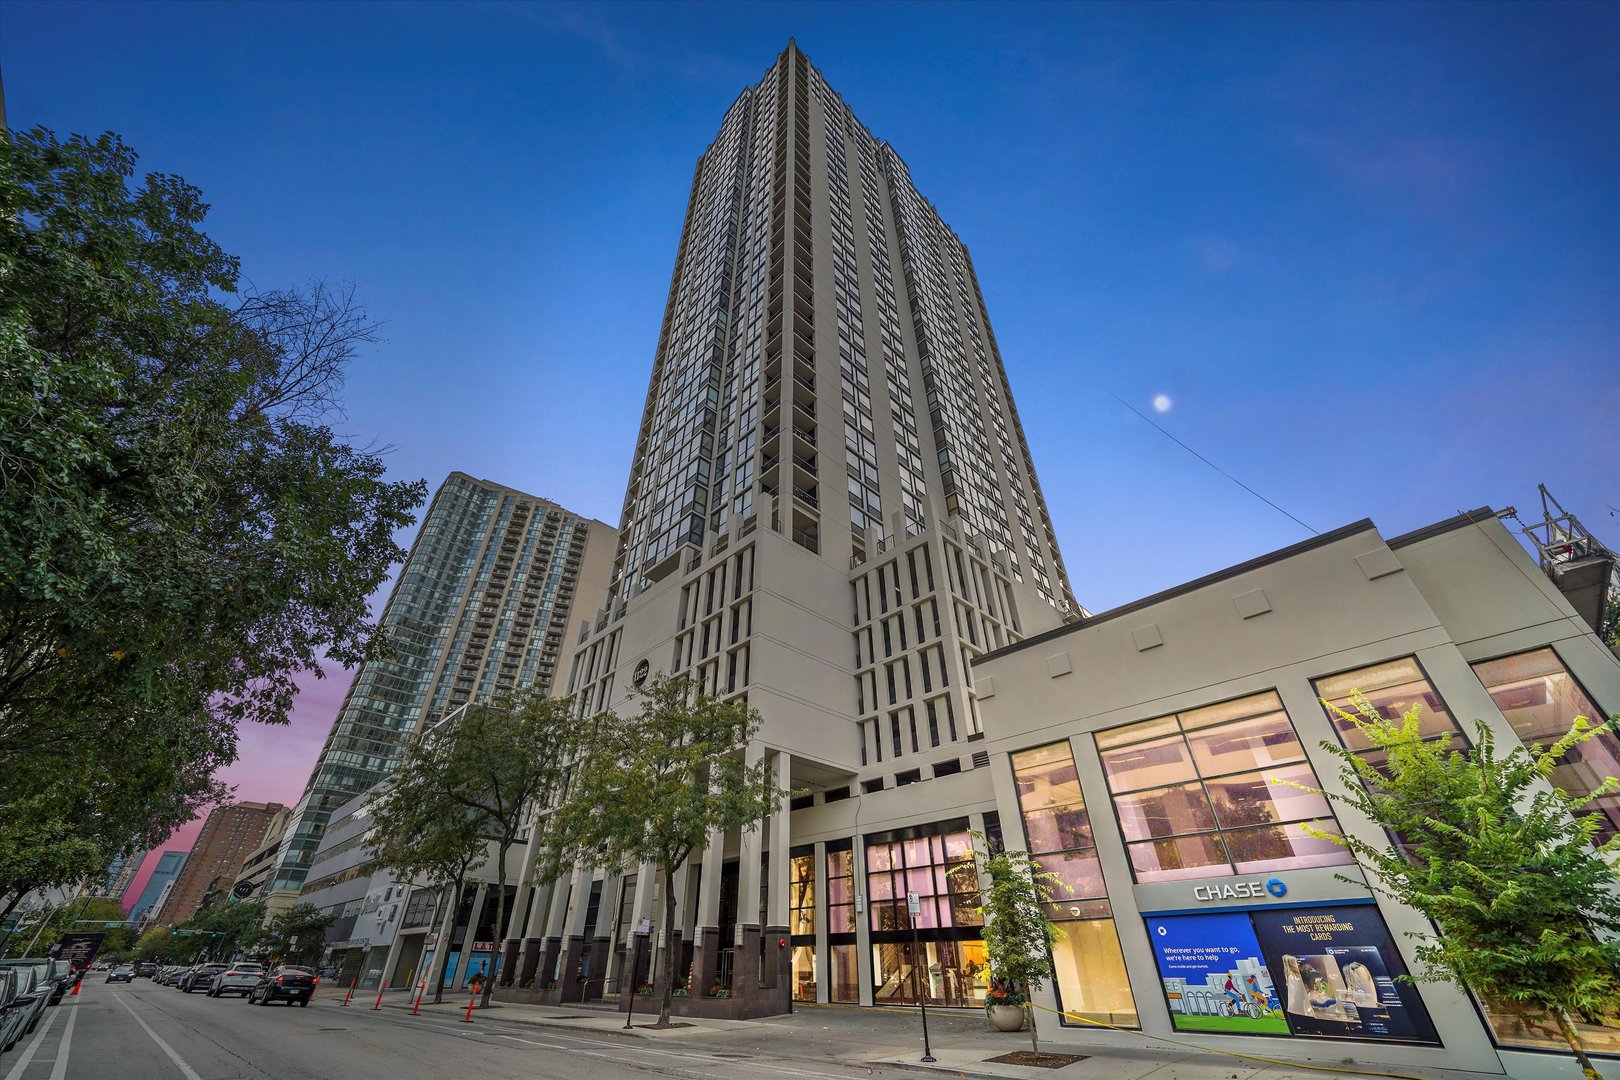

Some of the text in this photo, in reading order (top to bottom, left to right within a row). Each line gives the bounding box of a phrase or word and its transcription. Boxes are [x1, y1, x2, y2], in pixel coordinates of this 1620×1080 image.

[634, 666, 649, 681] 1122
[1193, 881, 1266, 901] CHASE
[1292, 914, 1336, 924] INTRODUCING
[1282, 922, 1354, 934] THE MOST REWARDING
[1309, 932, 1333, 941] CARDS
[1192, 947, 1205, 955] you
[1205, 954, 1219, 962] help
